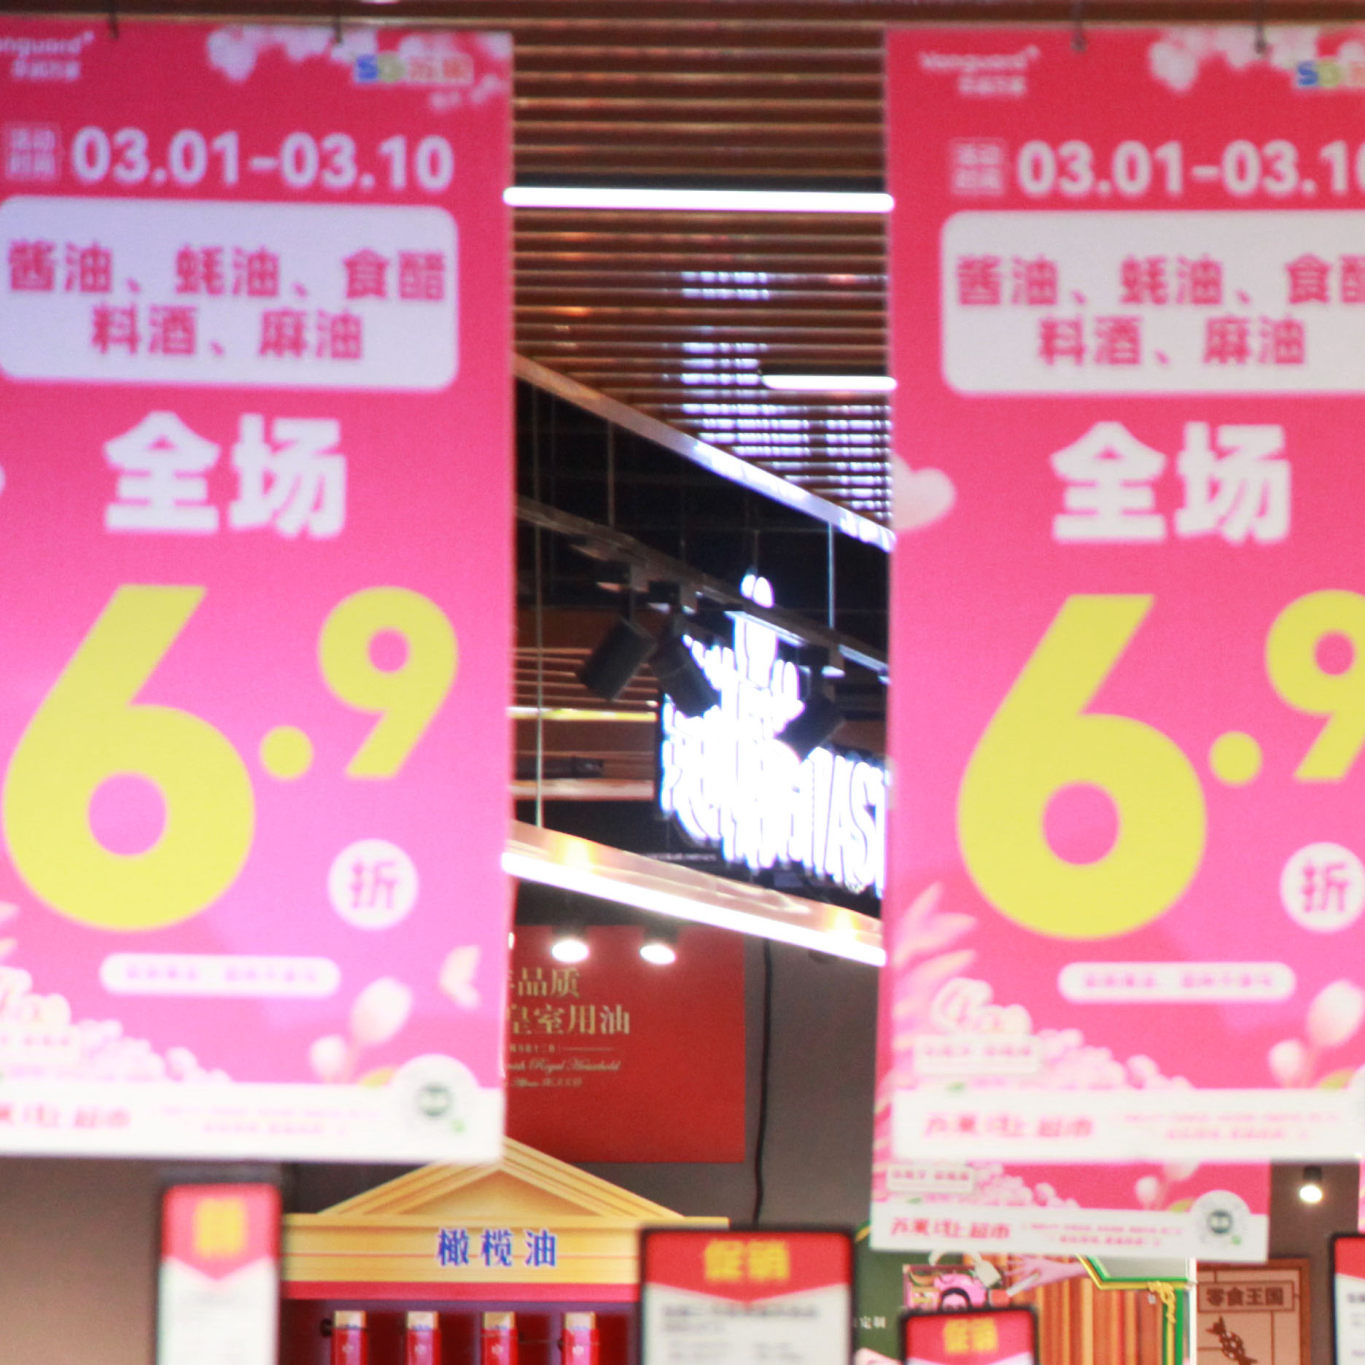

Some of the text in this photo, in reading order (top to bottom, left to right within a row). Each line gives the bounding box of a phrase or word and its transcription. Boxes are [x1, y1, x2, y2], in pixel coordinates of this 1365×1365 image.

[72, 126, 455, 192] 03.01-03.10
[8, 240, 446, 301] 酱油、蚝油、食醋
[91, 303, 364, 360] 料酒、麻油
[1036, 314, 1306, 367] 料酒、麻油
[102, 410, 348, 539] 全场
[1050, 421, 1292, 544] 全场
[1, 583, 460, 931] 6.9
[347, 858, 399, 912] 折
[1300, 861, 1352, 914] 折
[435, 1225, 560, 1270] 橄榄油
